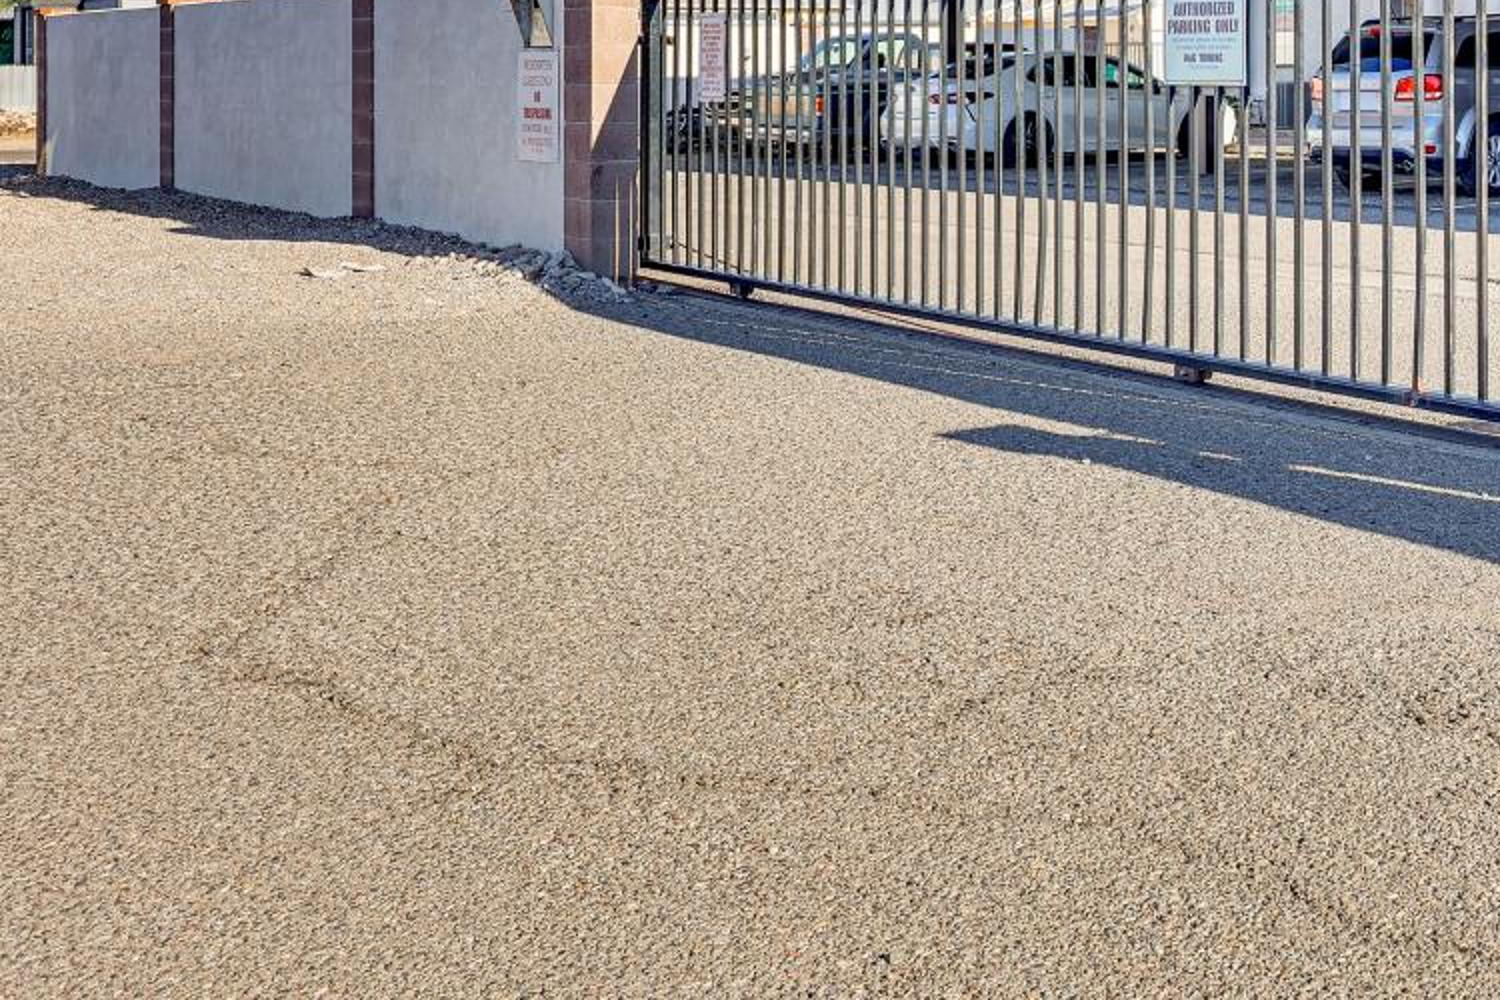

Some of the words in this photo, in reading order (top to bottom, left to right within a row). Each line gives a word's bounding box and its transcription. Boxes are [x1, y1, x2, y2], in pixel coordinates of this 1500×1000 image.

[1173, 1, 1235, 17] AUTHORIZED
[1167, 18, 1211, 35] PARKING
[1215, 18, 1240, 33] ONLY
